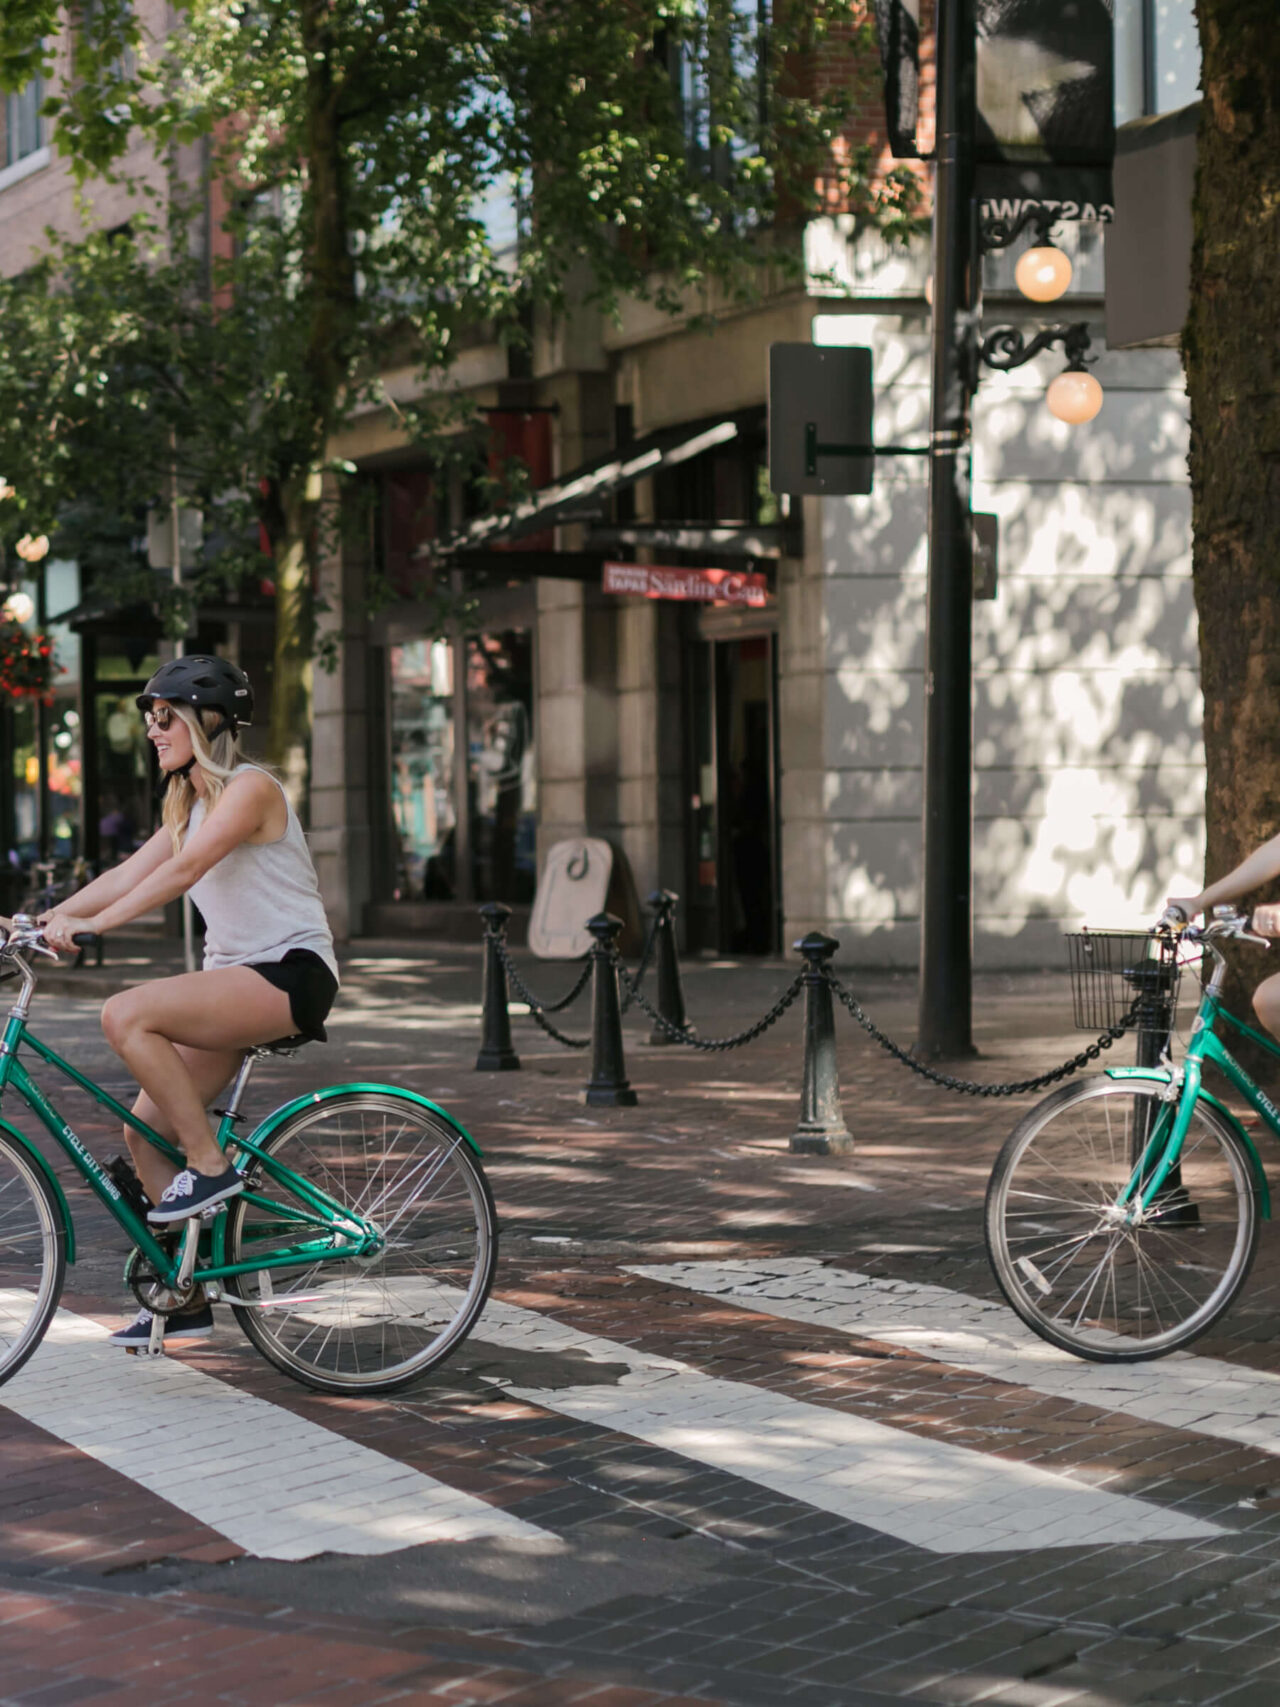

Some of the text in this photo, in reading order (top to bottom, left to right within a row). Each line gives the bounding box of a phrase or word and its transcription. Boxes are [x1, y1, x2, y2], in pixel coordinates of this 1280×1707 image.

[650, 573, 765, 603] Sardine Can
[1256, 1090, 1279, 1118] CYCLE
[62, 1125, 121, 1200] CYCLE CITY TOURS
